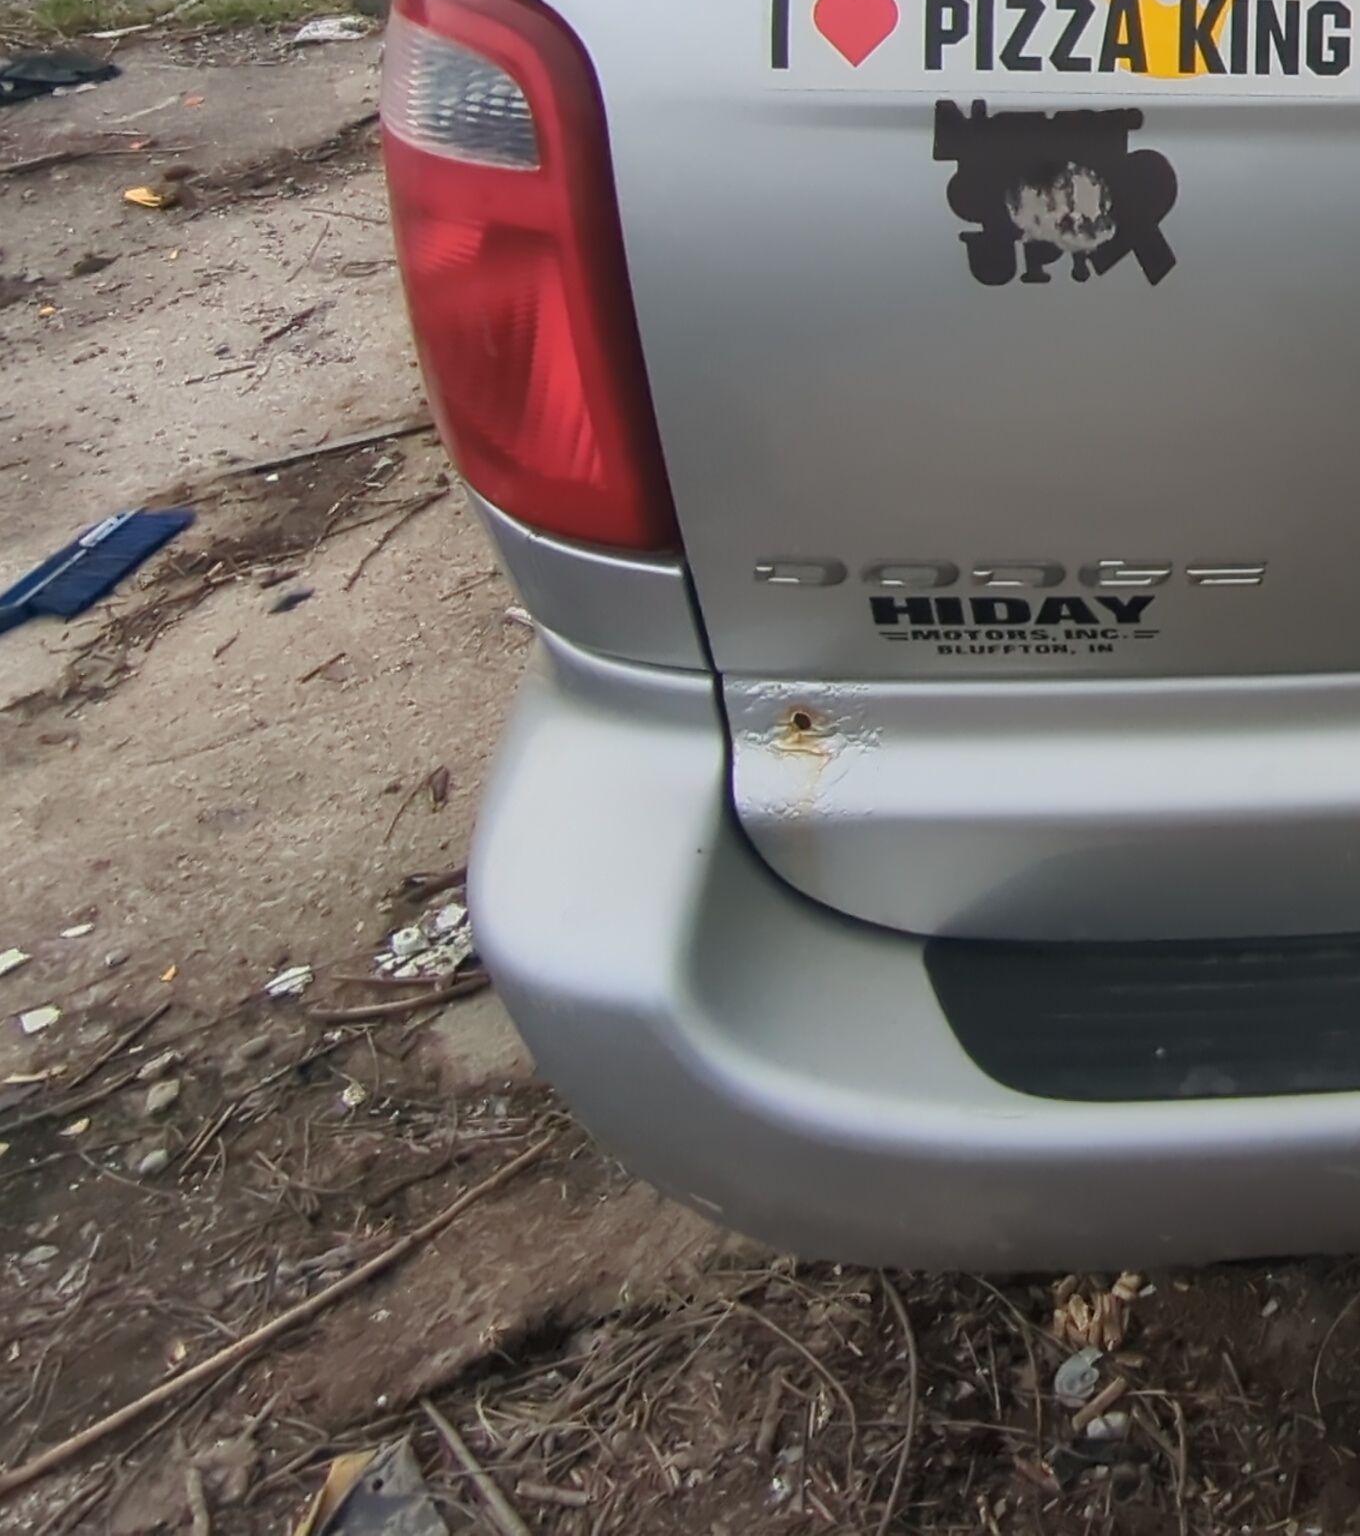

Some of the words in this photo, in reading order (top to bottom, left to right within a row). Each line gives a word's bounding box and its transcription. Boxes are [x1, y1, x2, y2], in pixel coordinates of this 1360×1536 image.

[755, 556, 1267, 589] DODGE
[869, 596, 1156, 626] HIDAY
[911, 629, 1058, 642] MOTORS,
[1064, 629, 1129, 640] INC.
[937, 644, 1076, 655] BLUFFTON,
[1089, 643, 1114, 654] IN
